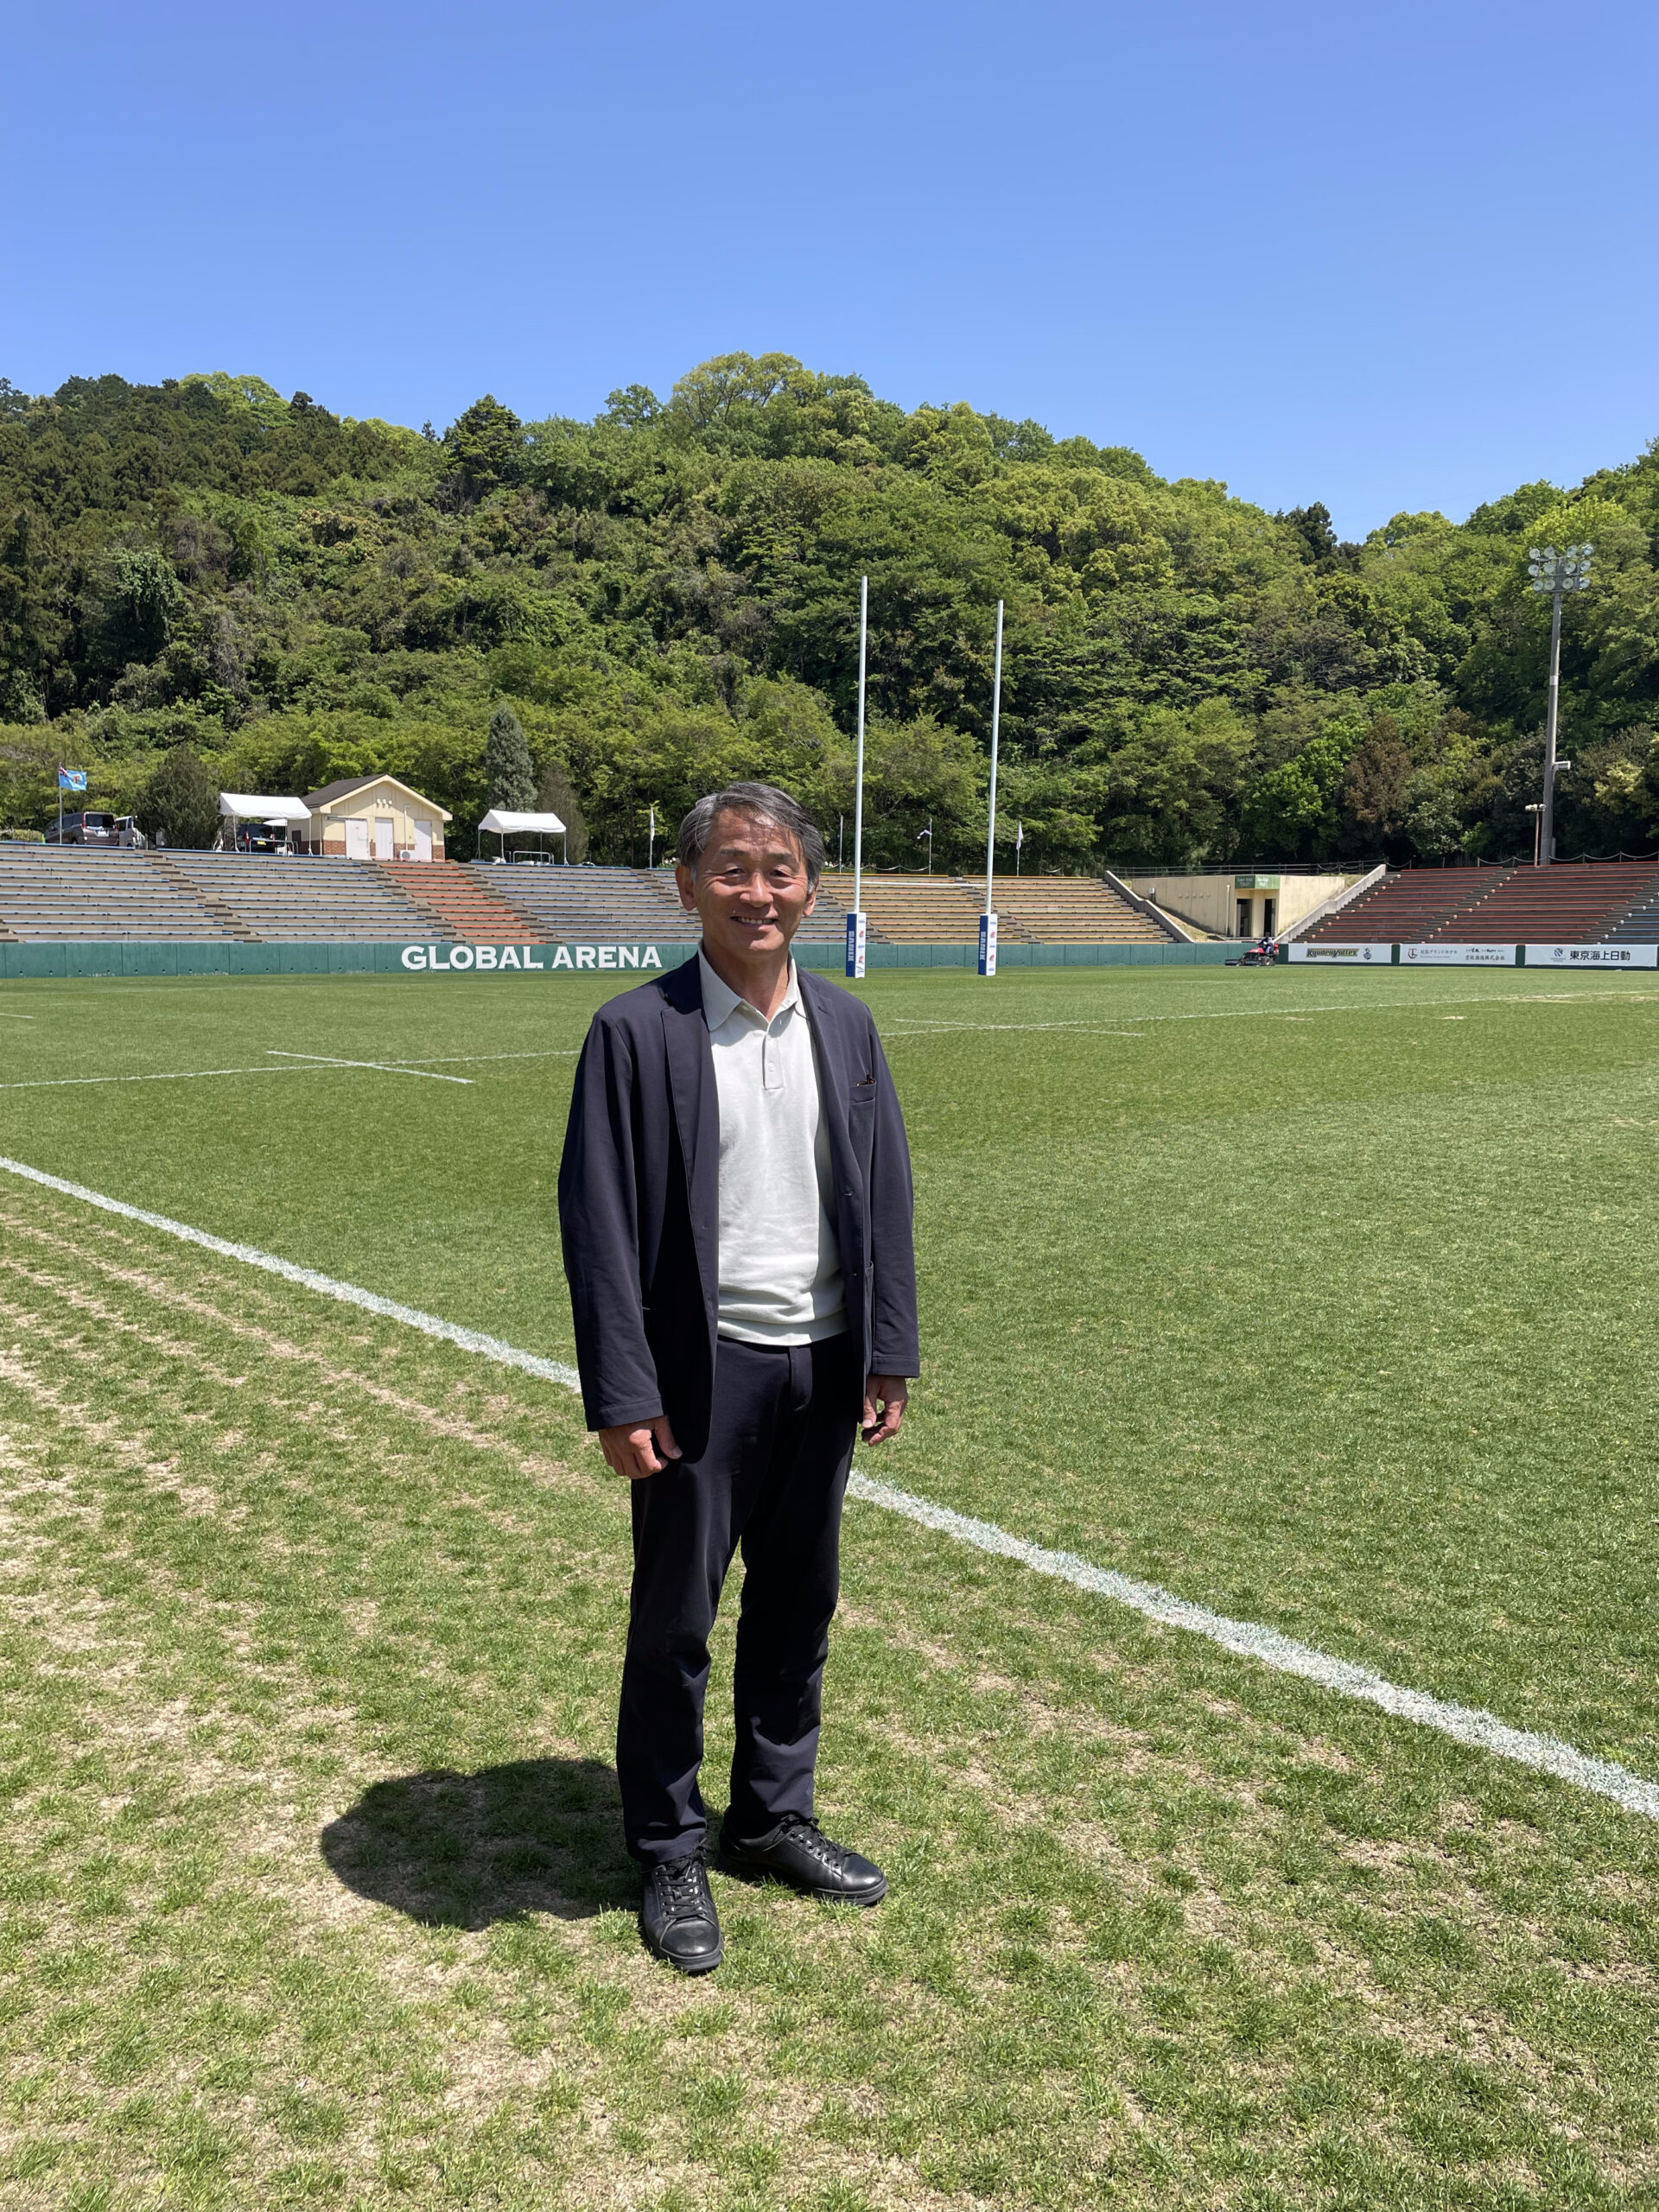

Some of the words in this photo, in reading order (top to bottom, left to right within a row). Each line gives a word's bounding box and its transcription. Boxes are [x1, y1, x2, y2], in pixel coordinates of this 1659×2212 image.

[401, 945, 543, 970] GLOBAL
[551, 945, 663, 969] ARENA
[1569, 950, 1630, 961] 東京海上日動
